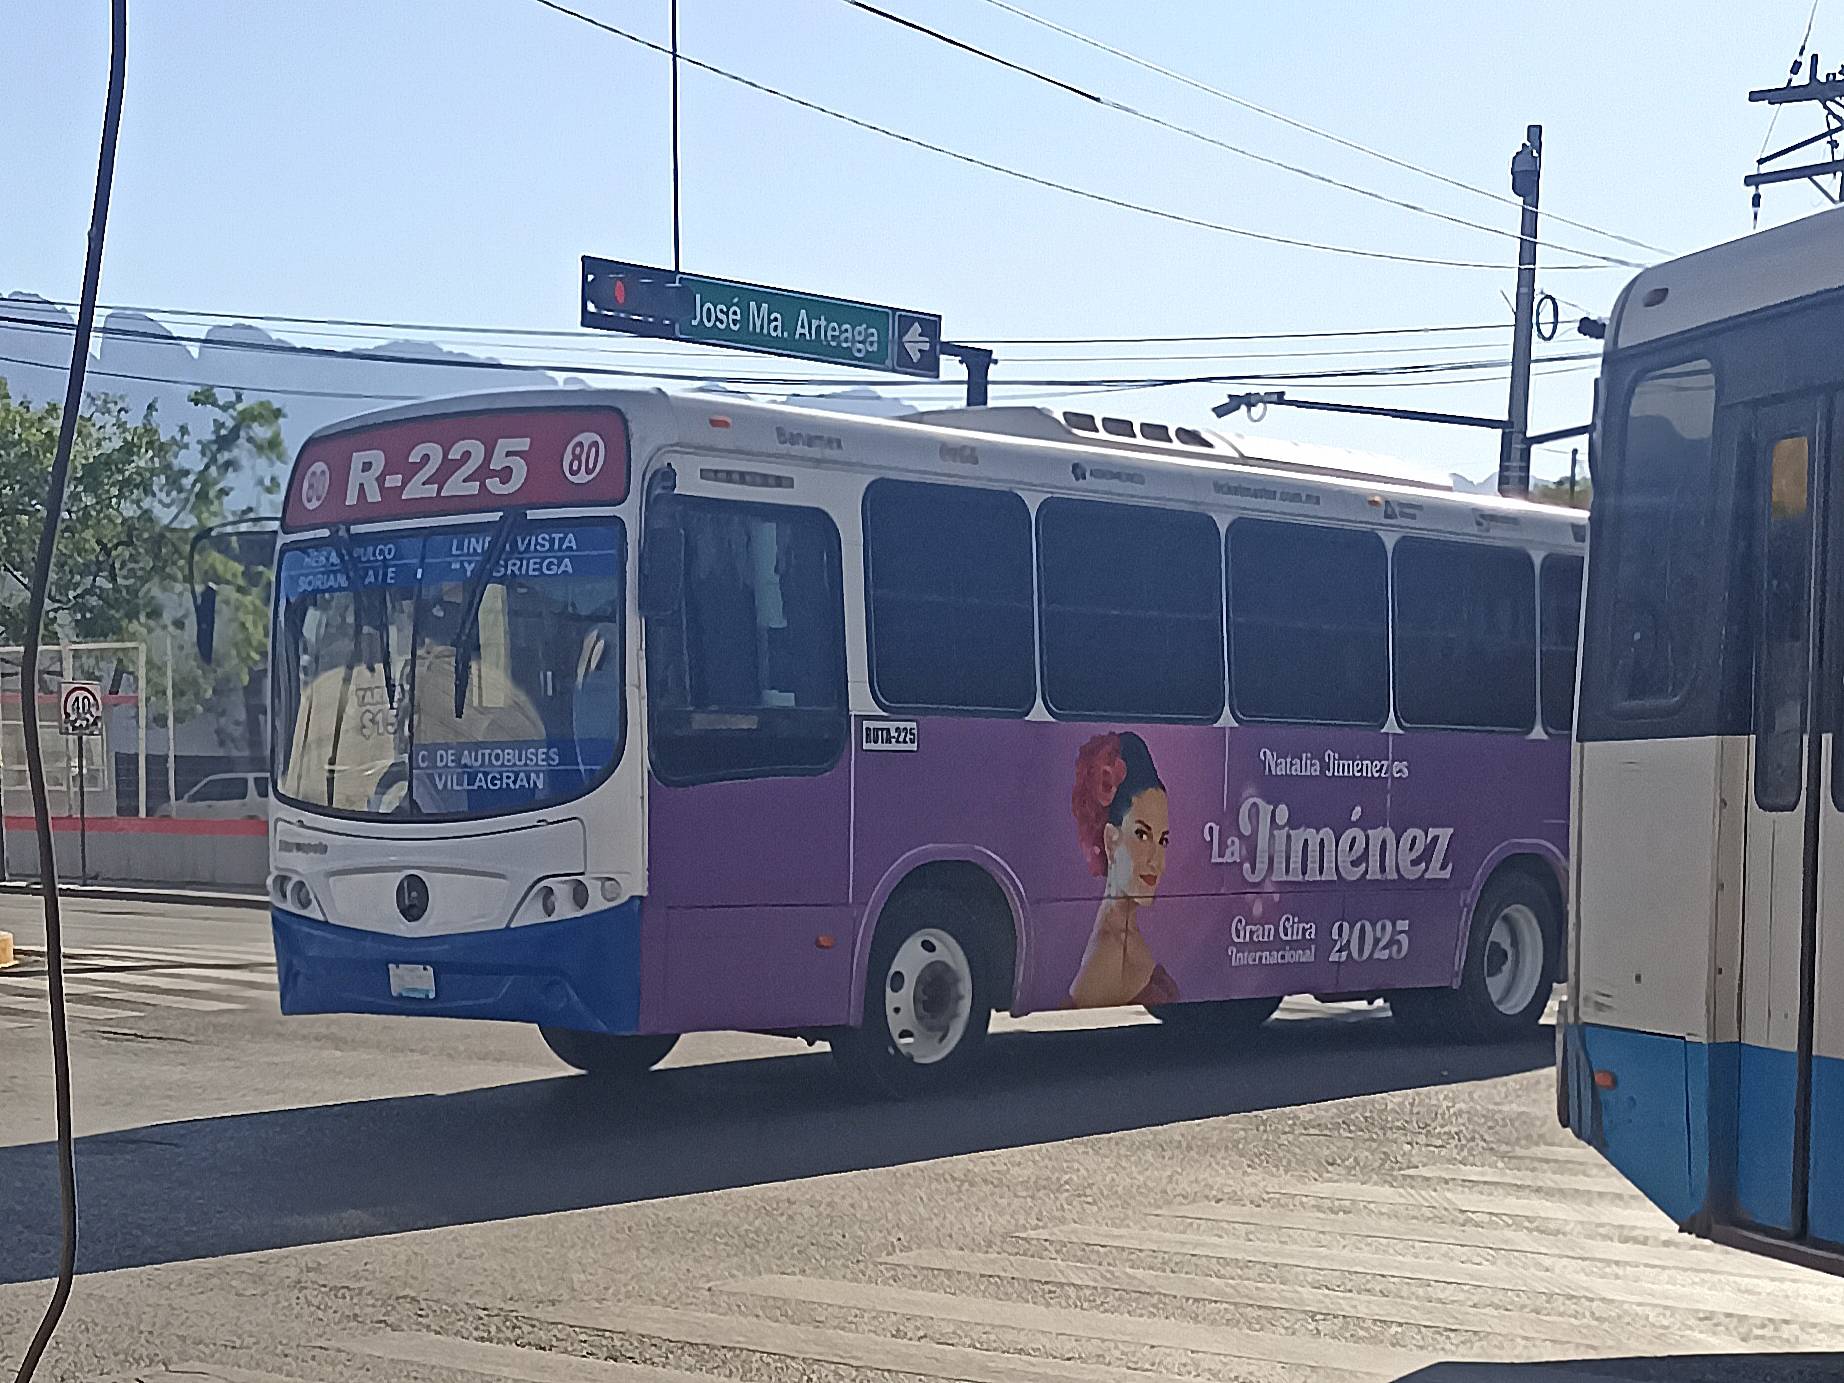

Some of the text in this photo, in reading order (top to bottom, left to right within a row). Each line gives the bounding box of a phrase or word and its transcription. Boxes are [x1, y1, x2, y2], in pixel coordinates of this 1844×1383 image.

[692, 293, 878, 357] José Ma. Arteaga
[568, 437, 601, 475] 80
[345, 437, 531, 506] R-225
[451, 533, 577, 555] LIN VISTA
[865, 726, 916, 745] RUTA-225
[436, 750, 456, 767] DE
[461, 748, 560, 767] AUTOBUSES
[1259, 748, 1320, 776] Natalia
[1392, 760, 1409, 778] es
[433, 772, 544, 790] VILLAGRAN
[1203, 797, 1454, 882] La Jiménez
[1231, 914, 1316, 943] Gran Gira
[1328, 919, 1409, 962] 2025
[1228, 945, 1316, 966] Internacional
